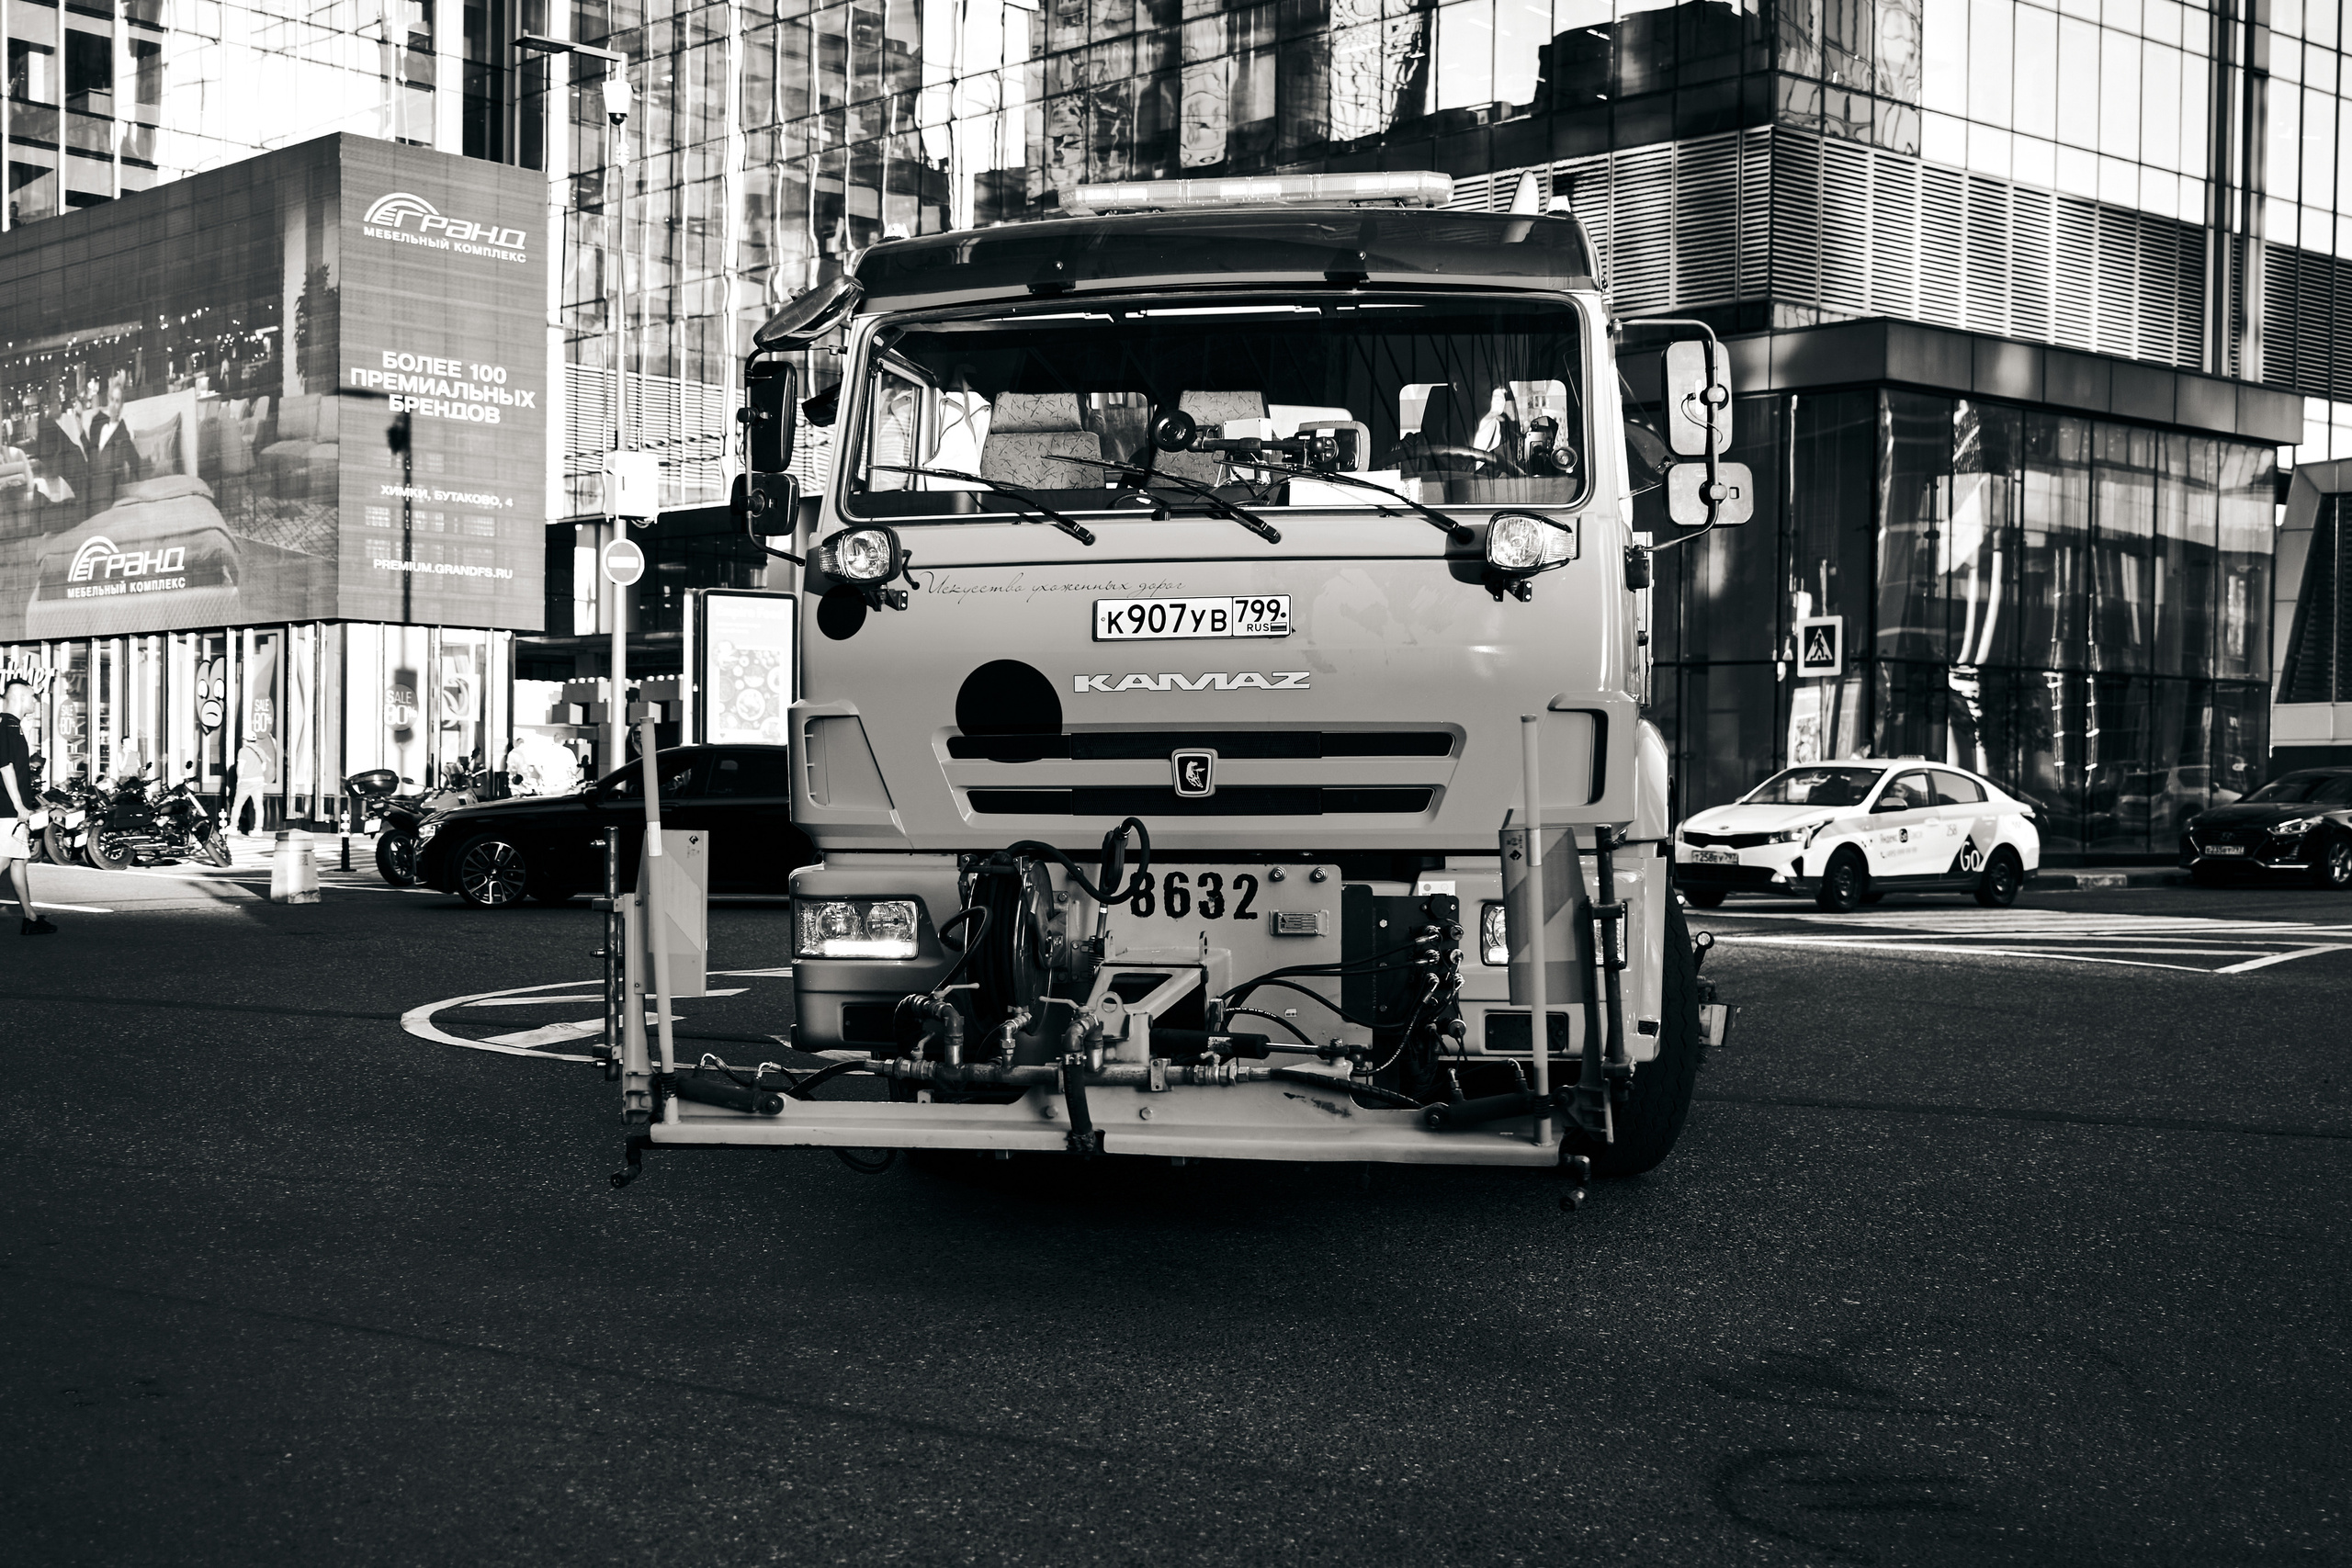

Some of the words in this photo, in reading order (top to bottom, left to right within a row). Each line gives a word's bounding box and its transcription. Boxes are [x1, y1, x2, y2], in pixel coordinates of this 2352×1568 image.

[364, 226, 449, 250] МЕБЕЛЬНЫЙ
[454, 242, 526, 263] КОМПЛЕКС
[382, 350, 462, 378] БОЛЕЕ
[469, 364, 506, 384] 100
[350, 367, 536, 409] ПРЕМИАЛЬНЫХ
[389, 394, 501, 423] БРЕНДОВ
[380, 485, 431, 502] ХИМКИ,
[435, 492, 503, 508] БУТАКОВО,
[505, 498, 513, 507] 4
[373, 558, 513, 579] PREMIUM.GRANDFS.RU
[67, 581, 127, 599] МЕБЕЛЬНЫЙ
[130, 577, 186, 592] КОМПЛЕКС
[1126, 578, 1185, 599] дорог
[1235, 599, 1281, 623] 799
[1247, 623, 1270, 632] RUS
[1073, 671, 1310, 693] KAMAZ
[254, 698, 269, 711] SALE
[386, 689, 412, 704] SALE
[1960, 841, 1980, 871] Go
[1130, 871, 1259, 920] 8632
